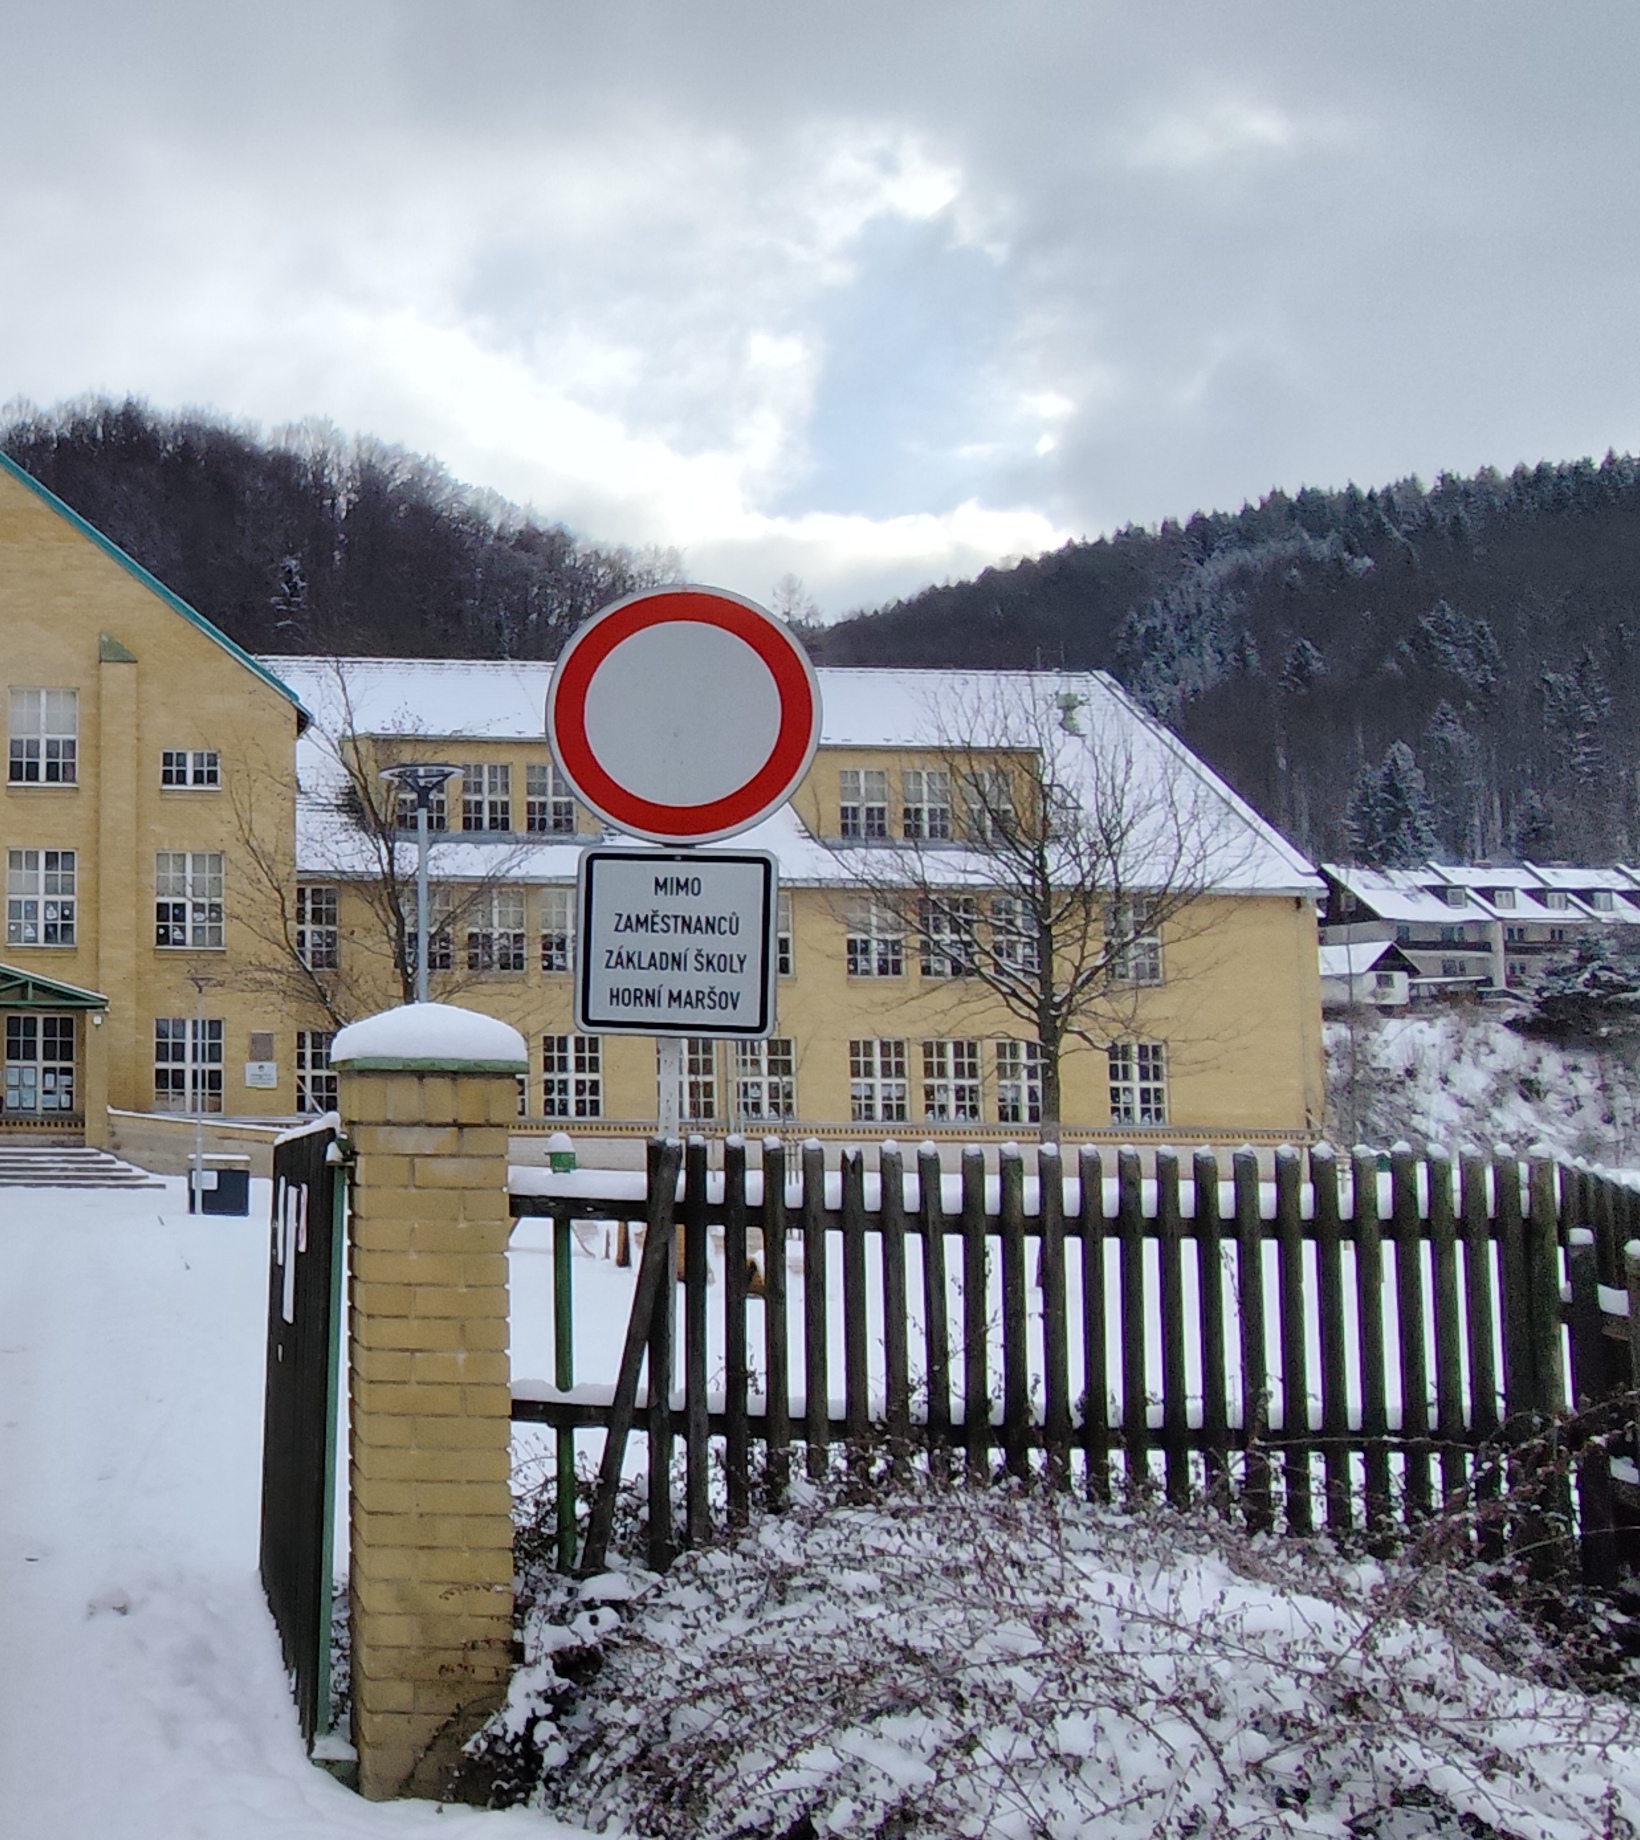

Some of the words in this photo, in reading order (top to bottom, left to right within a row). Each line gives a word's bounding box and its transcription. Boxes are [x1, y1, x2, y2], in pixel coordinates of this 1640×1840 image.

[654, 876, 701, 896] MIMO
[613, 909, 740, 935] ZAMĚSTNANCŮ
[604, 945, 690, 971] ZÁKLADNÍ
[693, 948, 747, 973] ŠKOLY
[609, 984, 663, 1008] HORNÍ
[667, 986, 740, 1011] MARŠOV
